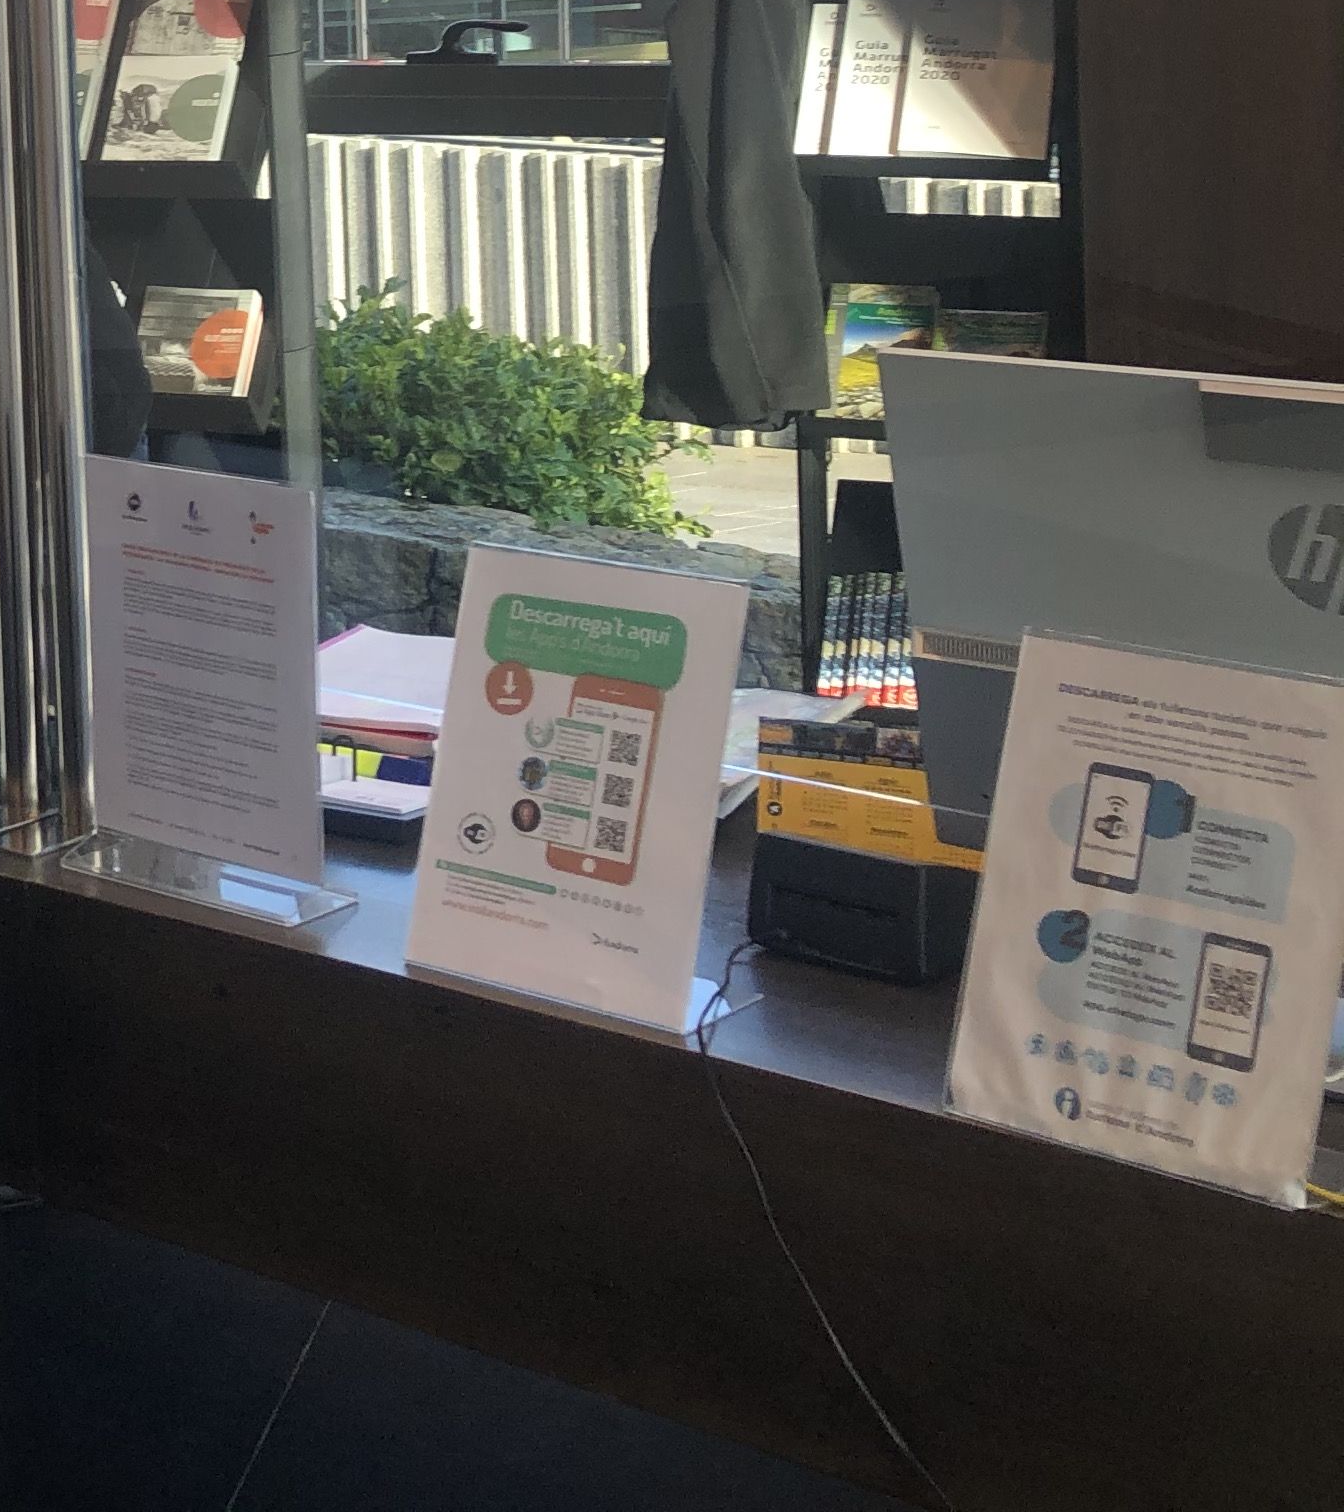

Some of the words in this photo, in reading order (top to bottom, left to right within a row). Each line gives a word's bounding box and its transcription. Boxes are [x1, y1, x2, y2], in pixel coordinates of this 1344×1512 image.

[855, 40, 889, 50] Guia
[925, 33, 959, 45] Guia
[922, 46, 997, 60] Marrugat
[921, 59, 987, 71] Andorra
[851, 75, 890, 84] 2020
[919, 70, 961, 81] 2020
[627, 625, 672, 648] aquí
[1059, 909, 1091, 953] 2
